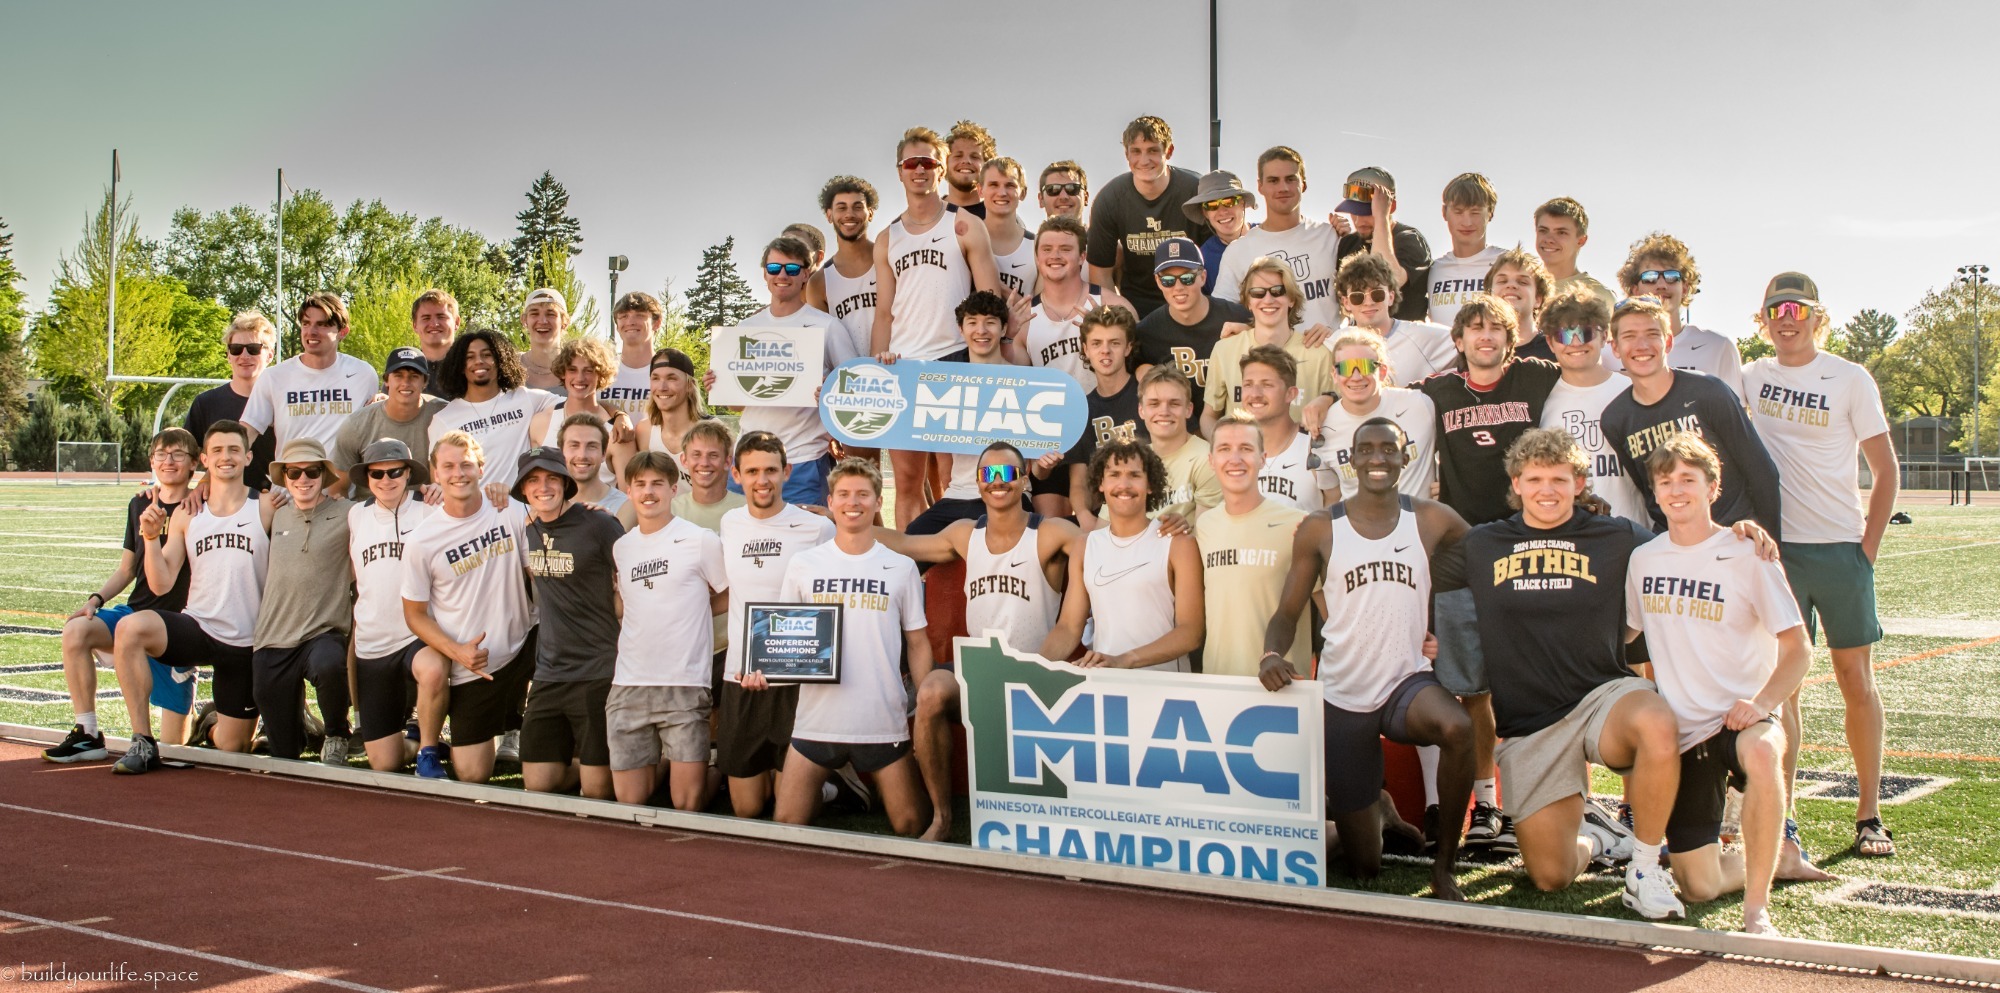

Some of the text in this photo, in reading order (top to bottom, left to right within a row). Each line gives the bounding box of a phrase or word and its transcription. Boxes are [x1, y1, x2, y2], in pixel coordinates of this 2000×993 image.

[1146, 216, 1162, 231] BU
[894, 249, 947, 277] BETHEL
[1000, 272, 1025, 297] HEL
[1304, 278, 1330, 301] DAY
[1432, 279, 1485, 294] BETHE
[835, 292, 877, 320] BETHE
[1431, 292, 1456, 306] TRACK
[746, 342, 793, 357] MIAC
[1040, 337, 1080, 366] BETH
[727, 361, 805, 372] CHAMPIONS
[845, 376, 894, 394] MIAC
[918, 373, 947, 382] 2025
[950, 374, 983, 384] TRACK
[996, 377, 1027, 387] FIELD
[287, 388, 352, 404] BETHEL
[600, 387, 652, 400] BETHE
[825, 394, 904, 409] CHAMPIONS
[1759, 383, 1830, 411] BETHEL
[287, 402, 316, 416] TRACK
[329, 401, 353, 414] FIELD
[490, 408, 524, 425] ROYALS
[912, 383, 1066, 437] MIAC
[1462, 401, 1532, 428] EARNHARDT
[1758, 398, 1783, 419] TRACK
[1798, 407, 1829, 427] FIELD
[922, 433, 973, 444] OUTDOOR
[1472, 431, 1496, 446] 3
[1562, 410, 1604, 452] BU
[1258, 476, 1298, 501] THEL
[196, 533, 254, 557] BETHEL
[362, 541, 405, 567] BETH
[445, 525, 511, 564] BETHEL
[742, 541, 782, 554] CHAMPS
[1513, 540, 1576, 553] 2024 MIAC CHAMPS
[451, 554, 484, 577] TRACK
[489, 538, 515, 559] FIELD
[753, 557, 764, 568] BU
[631, 559, 669, 578] CHAMPS
[1344, 560, 1417, 594] BETHEL
[1493, 548, 1597, 587] BETHEL
[643, 578, 654, 589] BU
[812, 578, 889, 596] BETHEL
[970, 574, 1030, 602] BETHEL
[1513, 579, 1541, 590] TRACK
[1549, 578, 1573, 590] FIELD
[1642, 576, 1725, 603] BETHEL
[812, 593, 846, 604] TRACK
[860, 593, 889, 612] FIELD
[1642, 594, 1672, 615] TRACK
[1689, 599, 1724, 622] FIELD
[776, 620, 814, 631] MIAC
[764, 639, 820, 647] CONFERENCE
[766, 646, 817, 654] CHAMPIONS
[1010, 688, 1300, 801] MIAC
[1286, 801, 1300, 810] TM
[975, 799, 1319, 840] MINNESOTA INTERCOLLEGIATE ATHLETIC CONFERENCE
[977, 820, 1319, 887] CHAMPIONS
